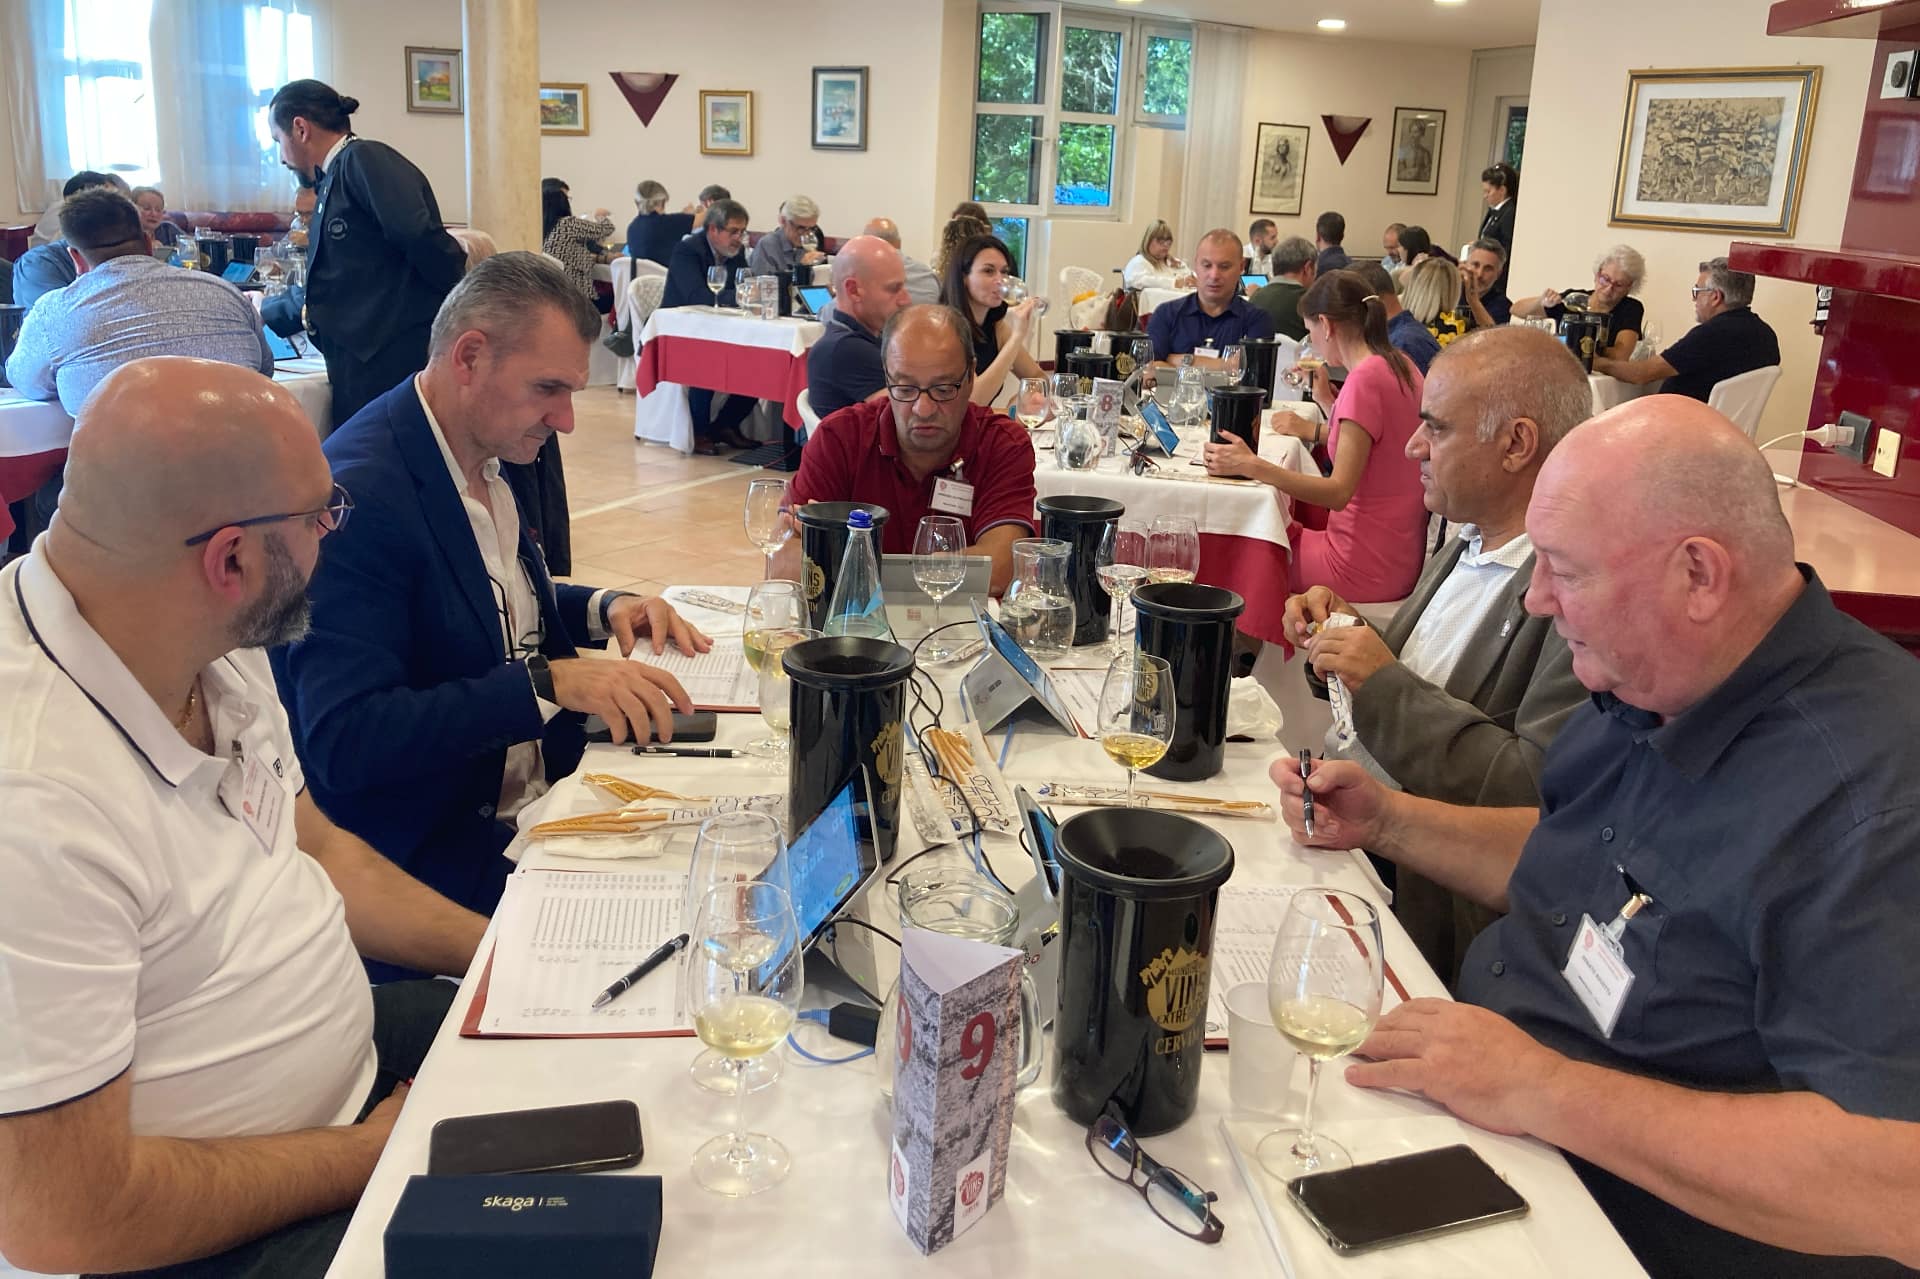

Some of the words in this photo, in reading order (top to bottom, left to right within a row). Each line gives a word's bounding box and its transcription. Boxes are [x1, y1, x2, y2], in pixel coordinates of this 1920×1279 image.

[1101, 394, 1113, 411] 8
[1165, 972, 1205, 1013] VIN
[959, 1010, 997, 1081] 9
[482, 1195, 534, 1211] skaga
